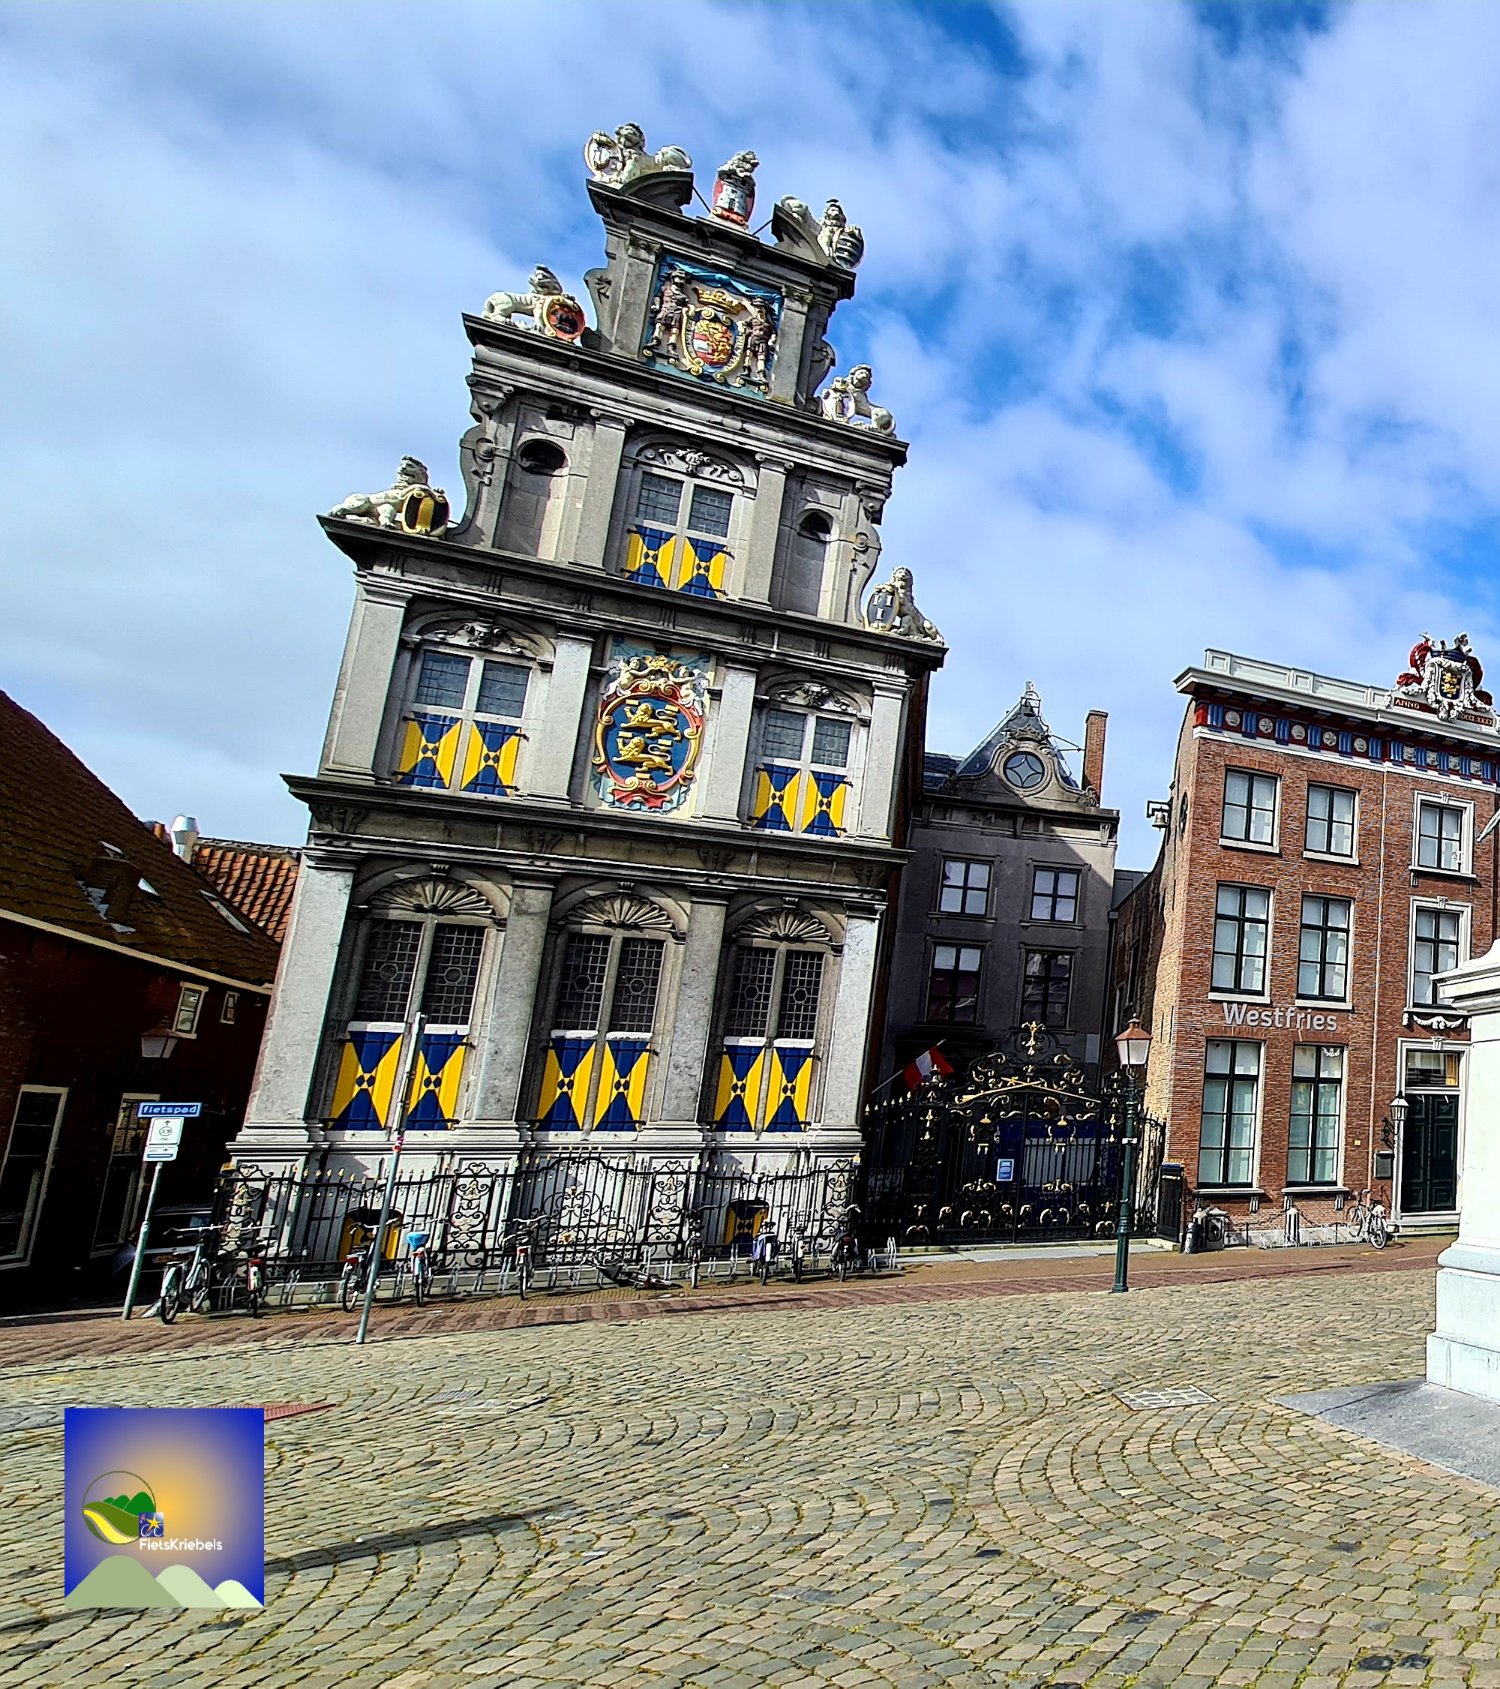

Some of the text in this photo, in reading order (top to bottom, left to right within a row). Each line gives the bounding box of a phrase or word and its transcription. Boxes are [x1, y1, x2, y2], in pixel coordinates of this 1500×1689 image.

[1395, 699, 1420, 710] ANNO
[1222, 1002, 1338, 1031] Westfries
[143, 1105, 197, 1115] fietspad
